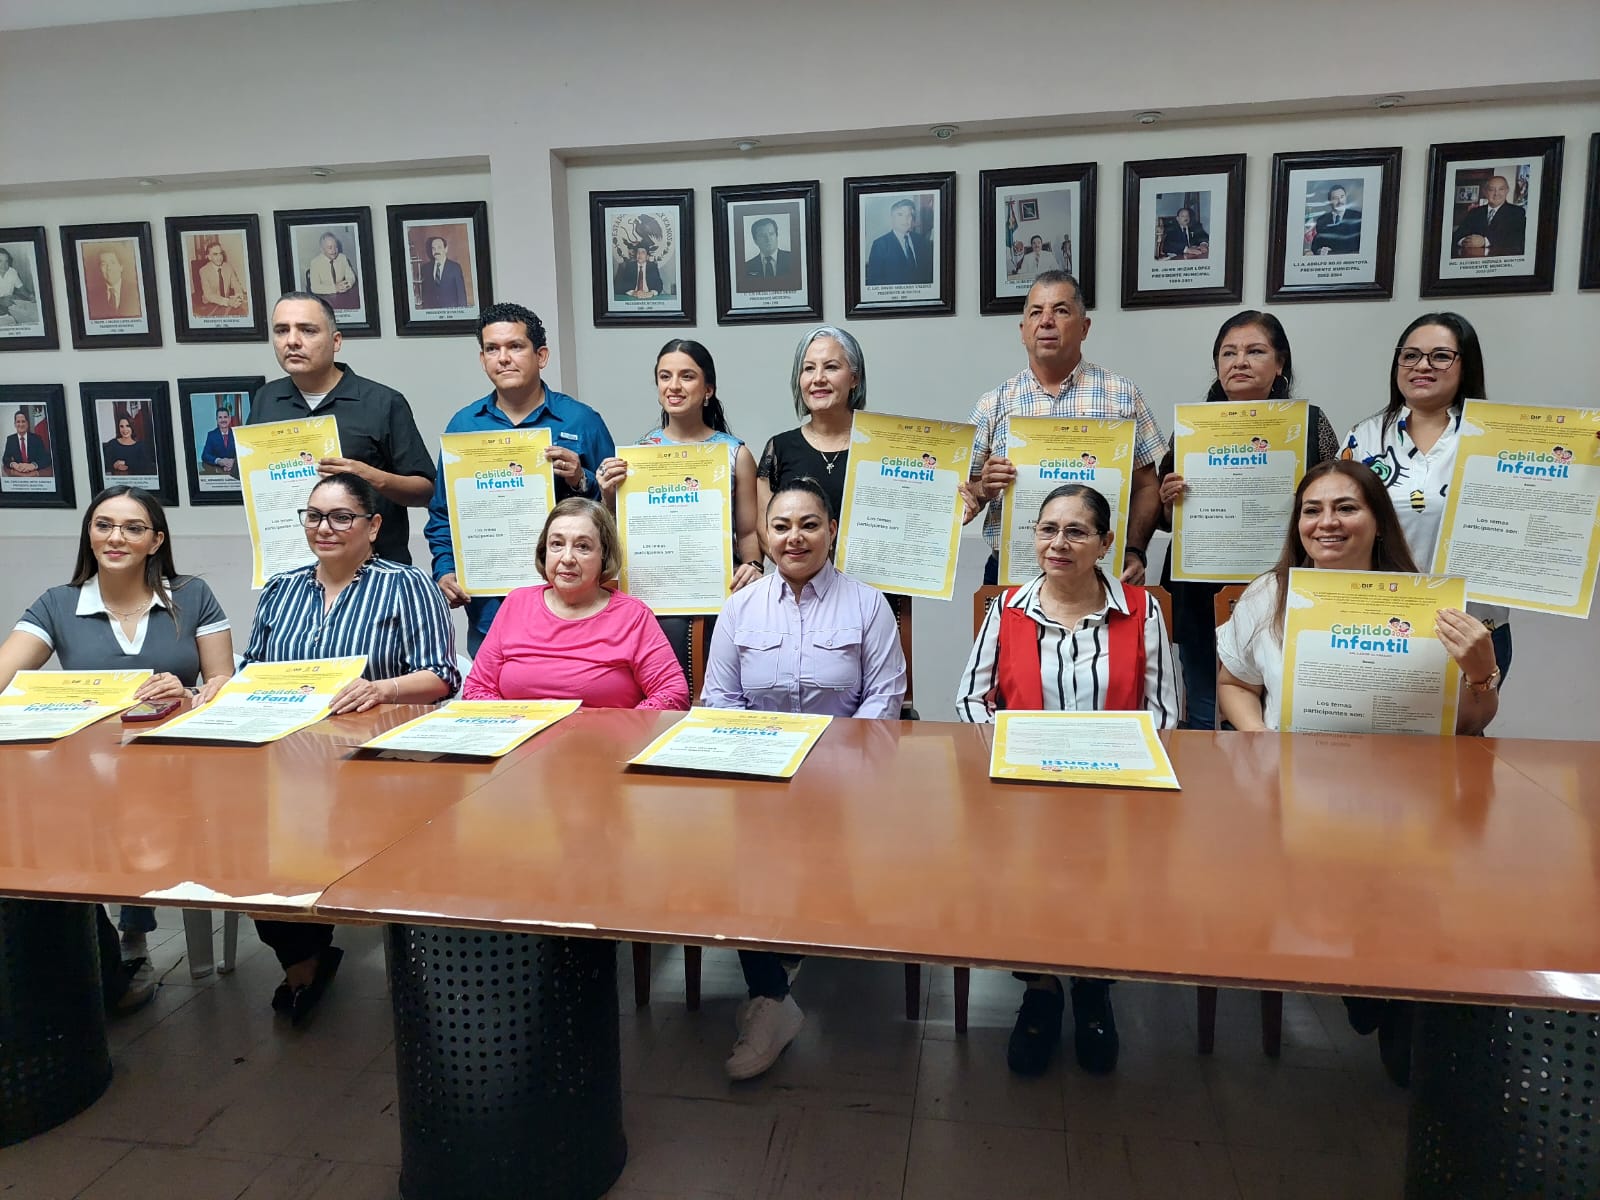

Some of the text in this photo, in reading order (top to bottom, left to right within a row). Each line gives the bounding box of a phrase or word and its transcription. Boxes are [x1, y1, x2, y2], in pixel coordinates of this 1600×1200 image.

[1208, 444, 1254, 455] Cabildo
[881, 456, 923, 468] Cabildo
[1208, 453, 1268, 466] Infantil
[1498, 450, 1554, 463] Cabildo
[268, 459, 303, 471] Cabildo
[1039, 459, 1083, 468] Cabildo
[1496, 460, 1569, 478] Infantil
[270, 465, 316, 481] Infantil
[475, 469, 512, 480] Cabildo
[880, 464, 935, 482] Infantil
[1039, 468, 1095, 481] Infantil
[476, 477, 525, 490] Infantil
[648, 484, 687, 494] Cabildo
[648, 492, 699, 505] Infantil
[1331, 624, 1391, 637] Cabildo
[1331, 634, 1409, 654] Infantil
[246, 694, 307, 703] Infantil
[1303, 707, 1348, 717] participantes
[712, 727, 778, 736] Infantil
